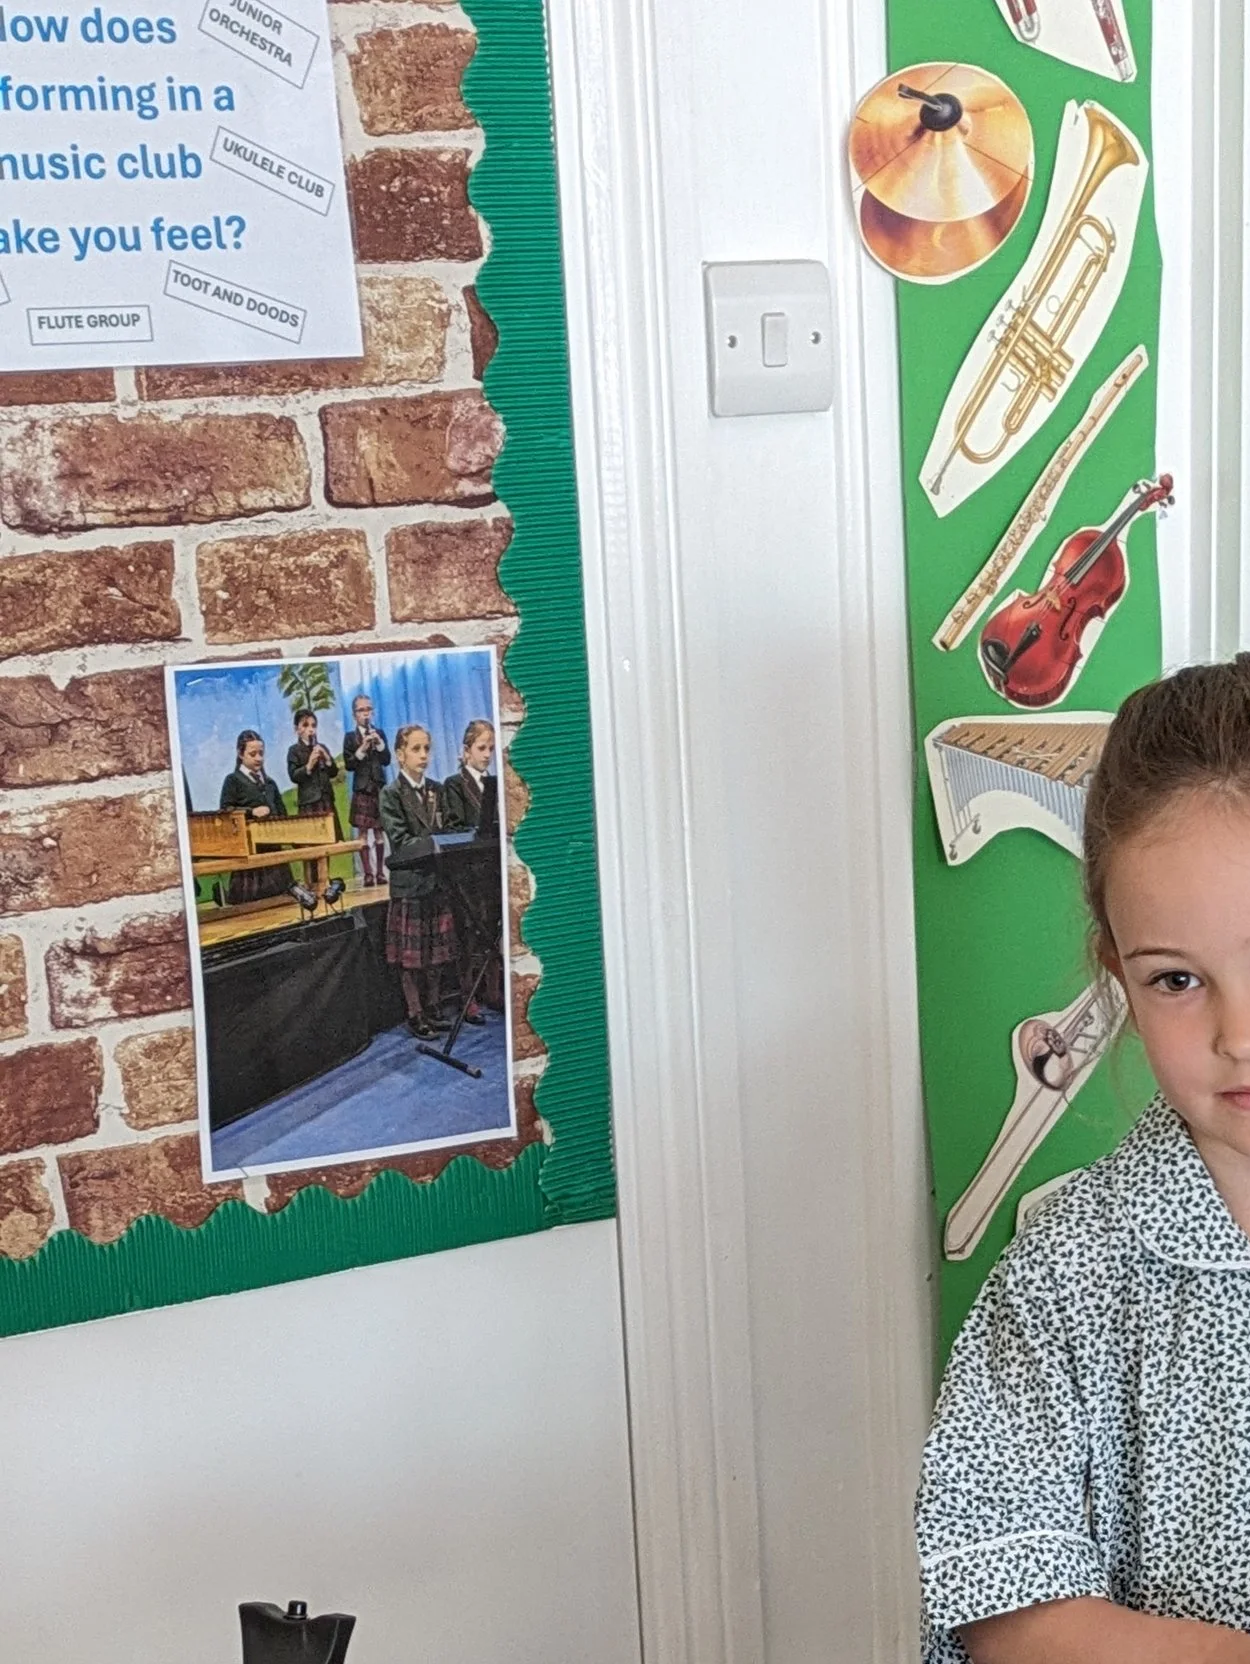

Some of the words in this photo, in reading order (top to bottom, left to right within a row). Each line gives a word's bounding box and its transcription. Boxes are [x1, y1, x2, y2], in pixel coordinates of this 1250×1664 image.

[80, 7, 178, 44] does
[229, 0, 283, 36] JUNIOR
[208, 8, 293, 67] ORCHESTRA
[167, 76, 203, 112] in
[213, 84, 236, 112] a
[117, 144, 203, 180] club
[222, 137, 285, 180] UKULELE
[287, 171, 326, 198] CLUB
[69, 226, 142, 262] you
[150, 215, 247, 251] feel?
[172, 269, 211, 294] TOOT
[211, 285, 245, 308] AND
[246, 297, 300, 328] DOODS
[37, 315, 84, 330] FLUTE
[86, 313, 141, 328] GROUP
